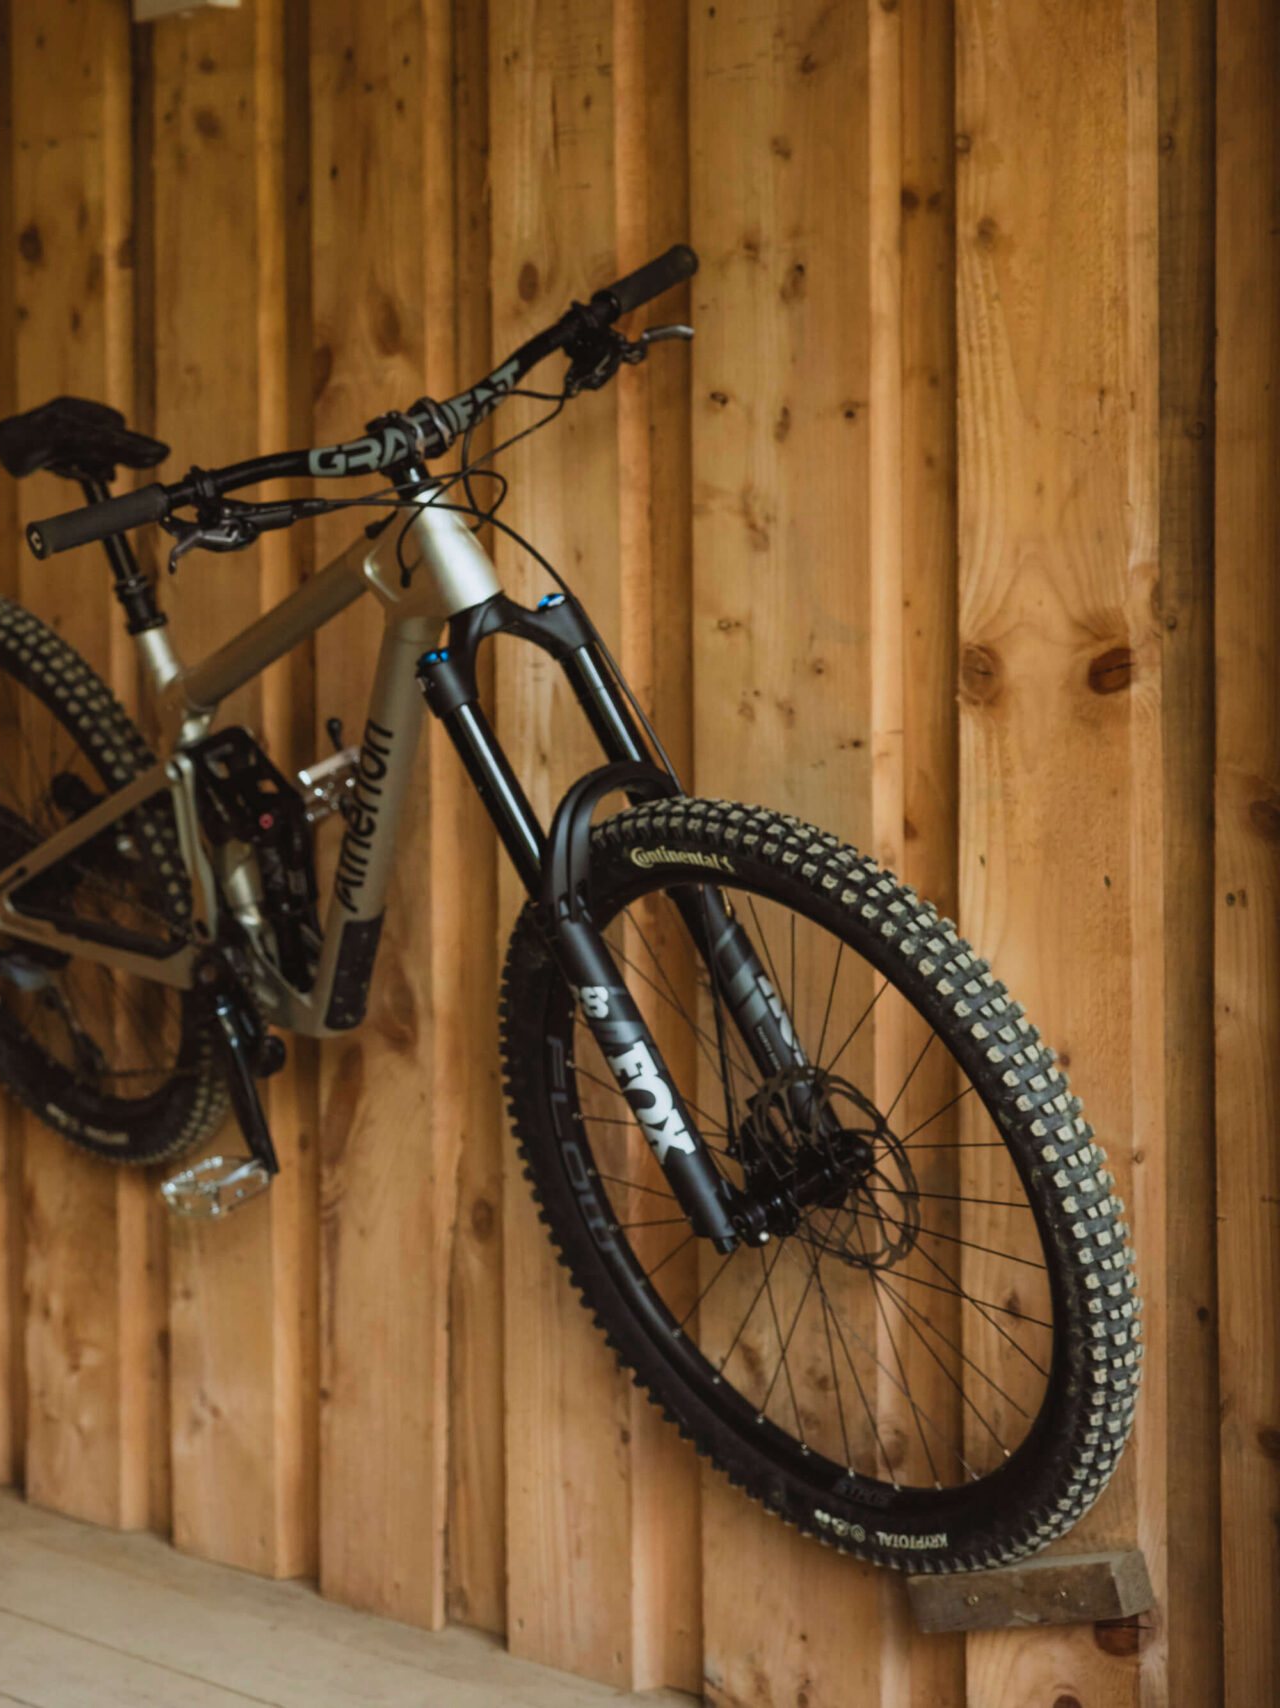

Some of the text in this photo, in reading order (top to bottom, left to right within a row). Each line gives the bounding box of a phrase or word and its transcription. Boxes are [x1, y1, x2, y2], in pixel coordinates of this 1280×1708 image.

[630, 845, 722, 869] Continental
[607, 1039, 696, 1165] FOX
[875, 1530, 949, 1550] KRYPTOTAL
